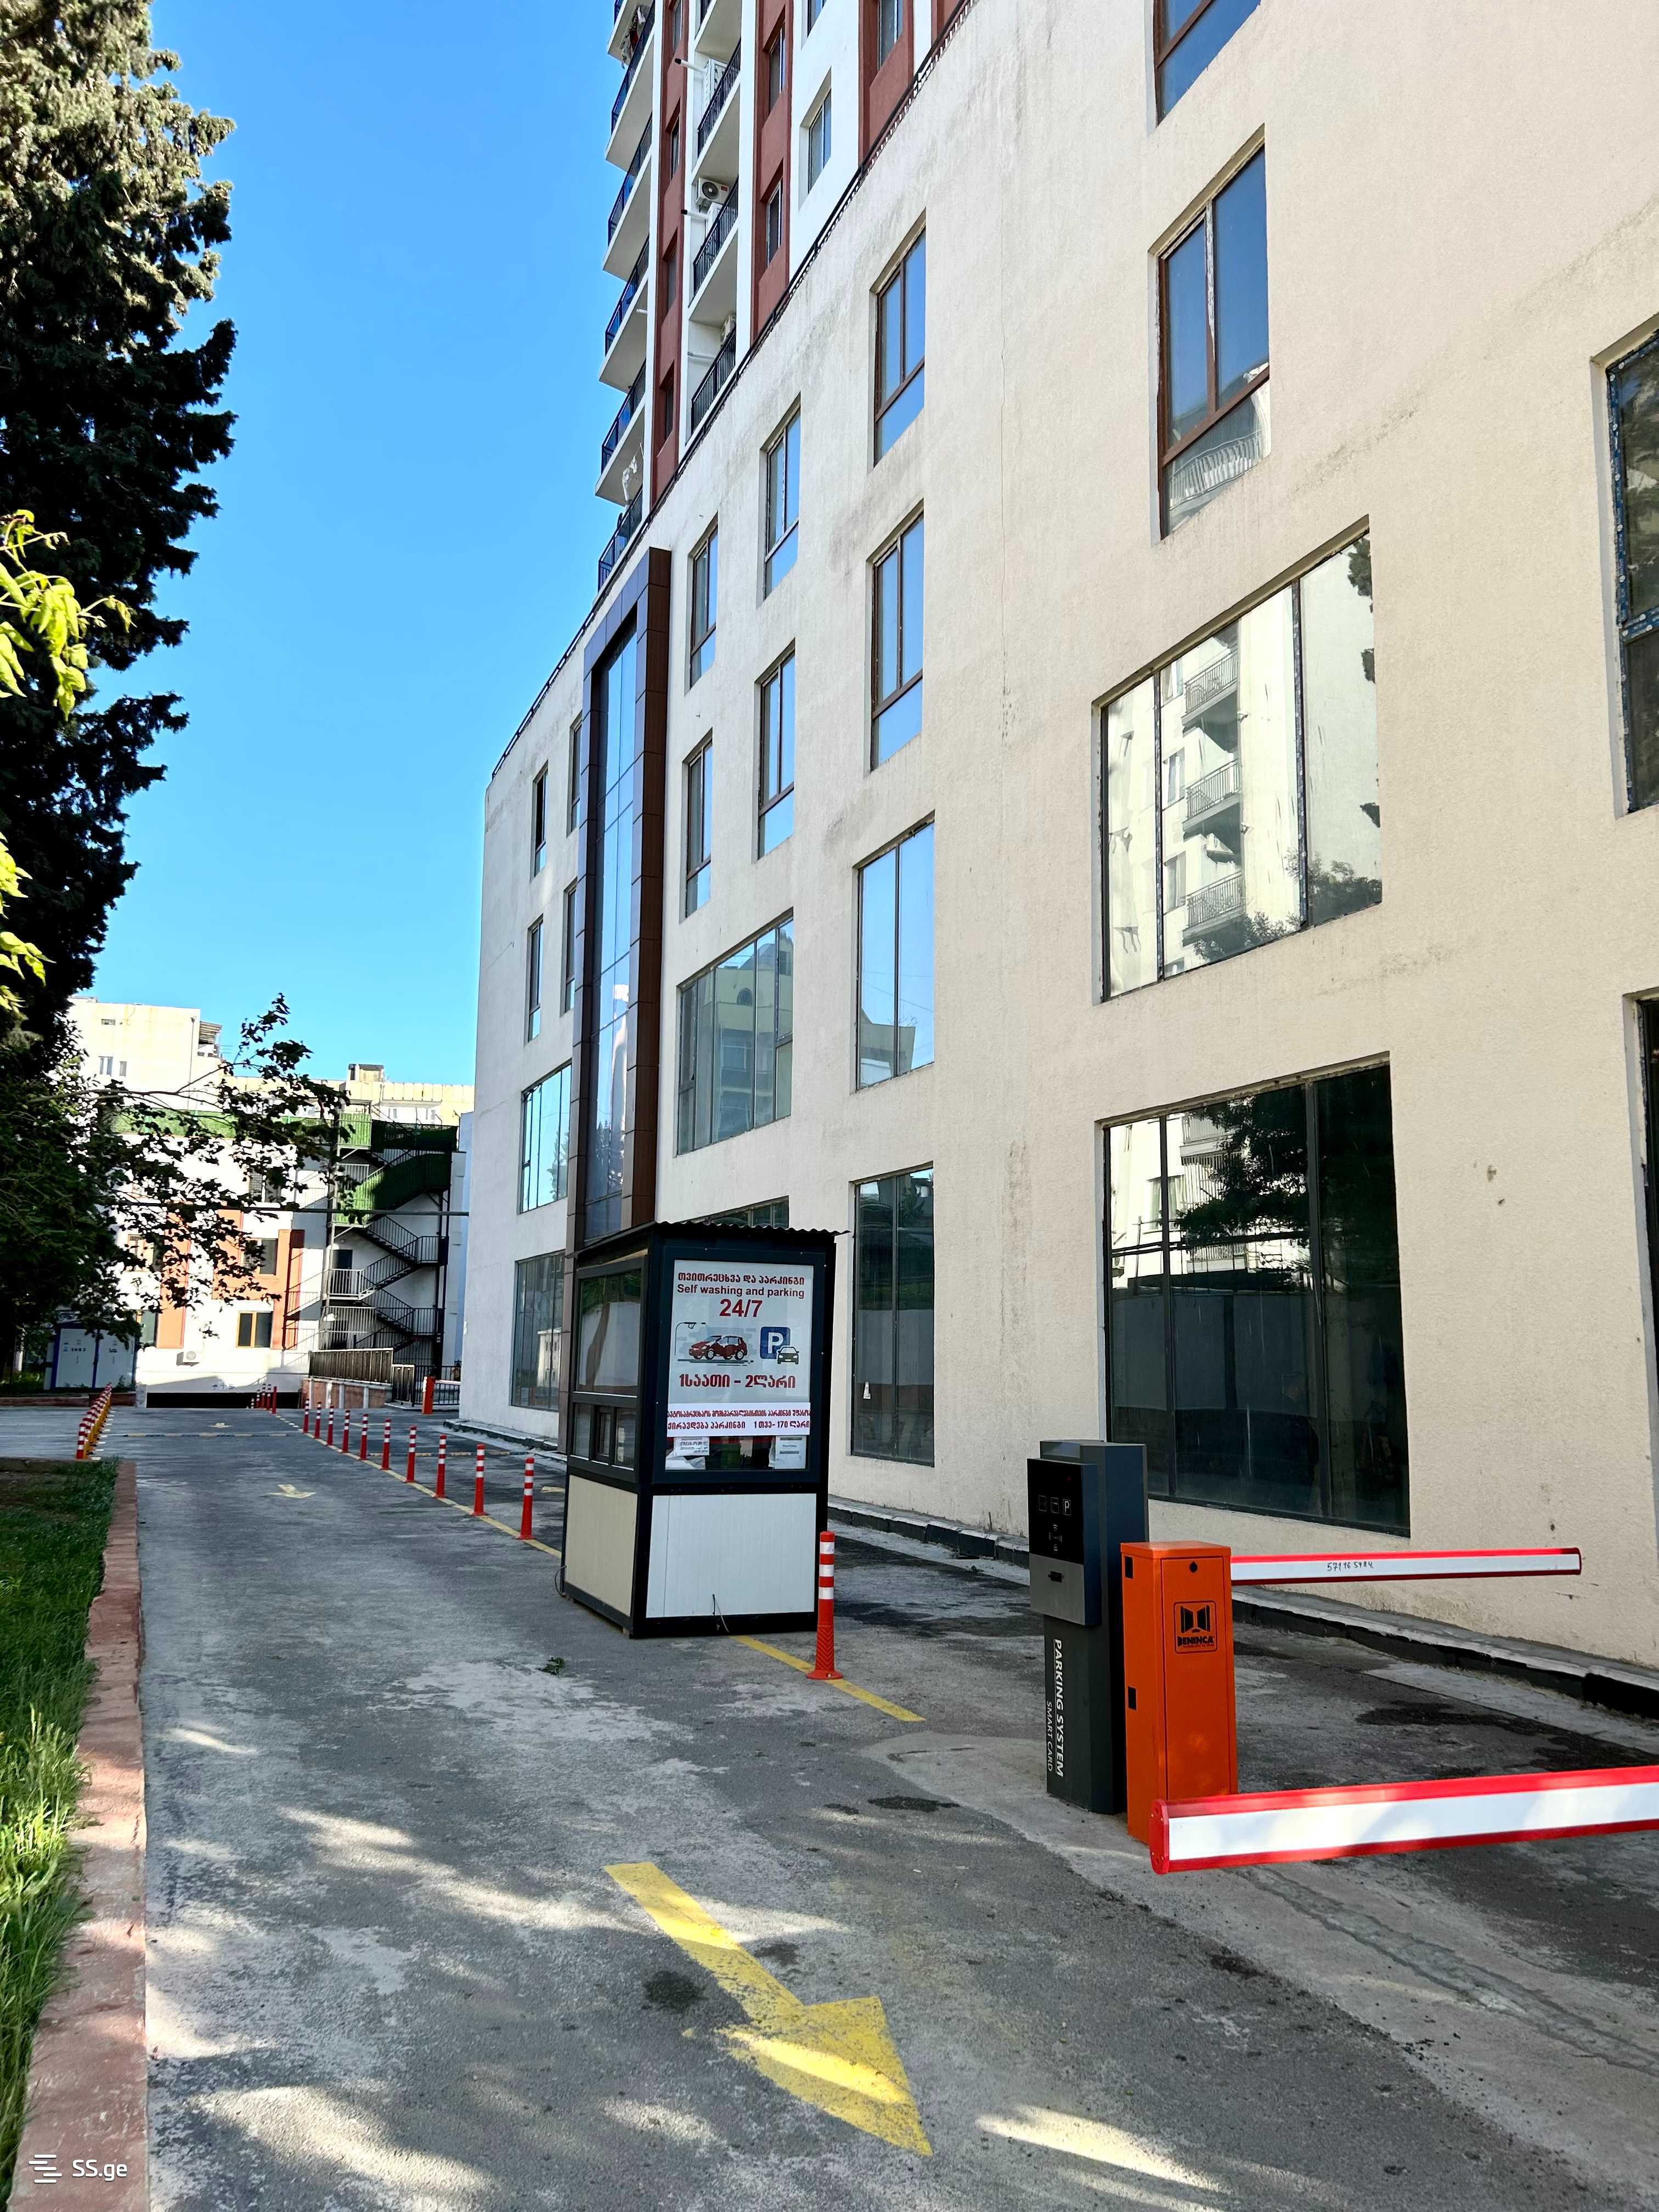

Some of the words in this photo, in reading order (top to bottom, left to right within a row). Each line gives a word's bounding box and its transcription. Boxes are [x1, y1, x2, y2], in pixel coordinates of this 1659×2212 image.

[678, 1272, 741, 1283] თვითრეცხვა
[743, 1275, 756, 1284] და
[759, 1276, 804, 1285] პარკინგი
[677, 1284, 698, 1293] Self
[700, 1285, 742, 1297] washing
[746, 1287, 764, 1295] and
[768, 1288, 804, 1299] parking
[719, 1298, 763, 1317] 24/7
[768, 1332, 784, 1354] P
[679, 1374, 730, 1387] 1საათი
[745, 1375, 795, 1388] 2ლარი
[668, 1421, 708, 1430] ქირავდება
[710, 1421, 745, 1429] პარკინგი
[1055, 1639, 1063, 1711] PARKING
